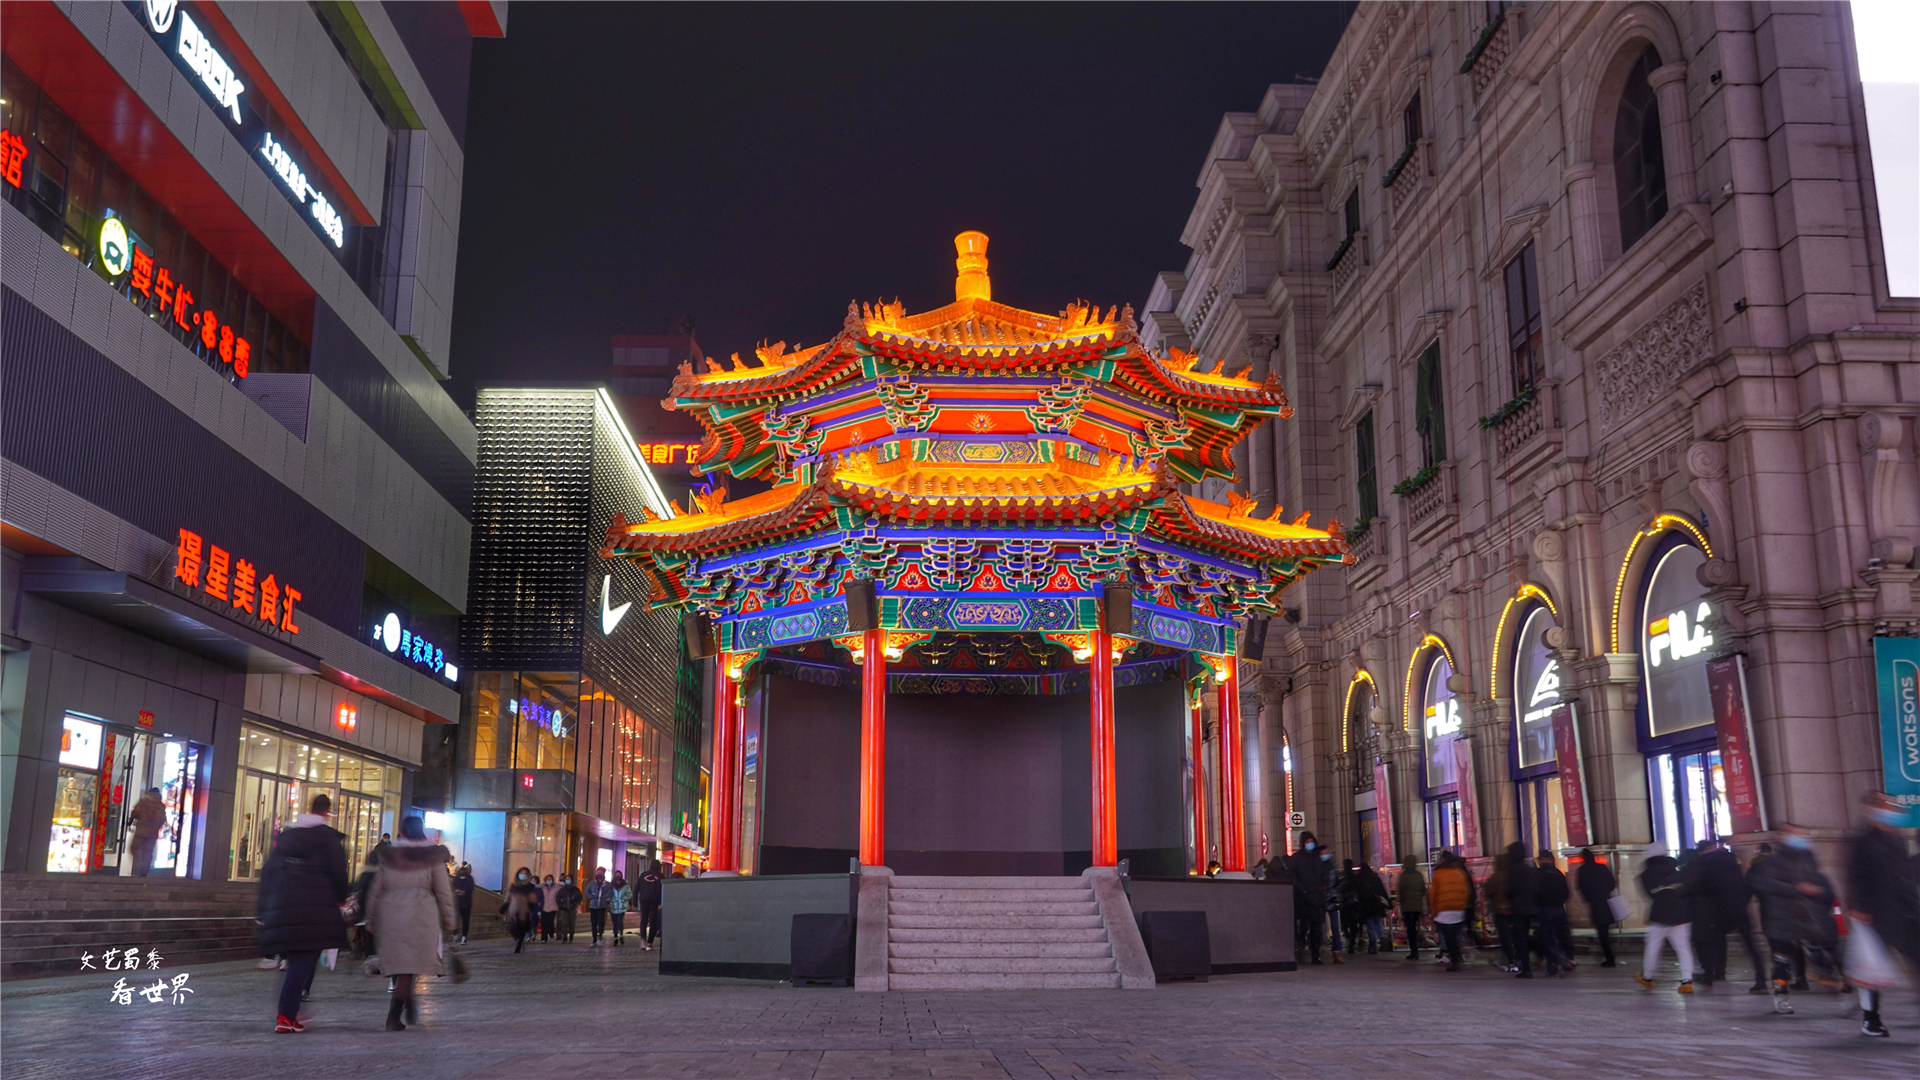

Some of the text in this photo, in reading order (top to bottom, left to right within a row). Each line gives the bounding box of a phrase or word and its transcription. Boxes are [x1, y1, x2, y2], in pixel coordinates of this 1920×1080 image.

[175, 527, 302, 635] 璟星美食汇
[1426, 698, 1462, 740] FILA
[1901, 676, 1920, 766] watsons
